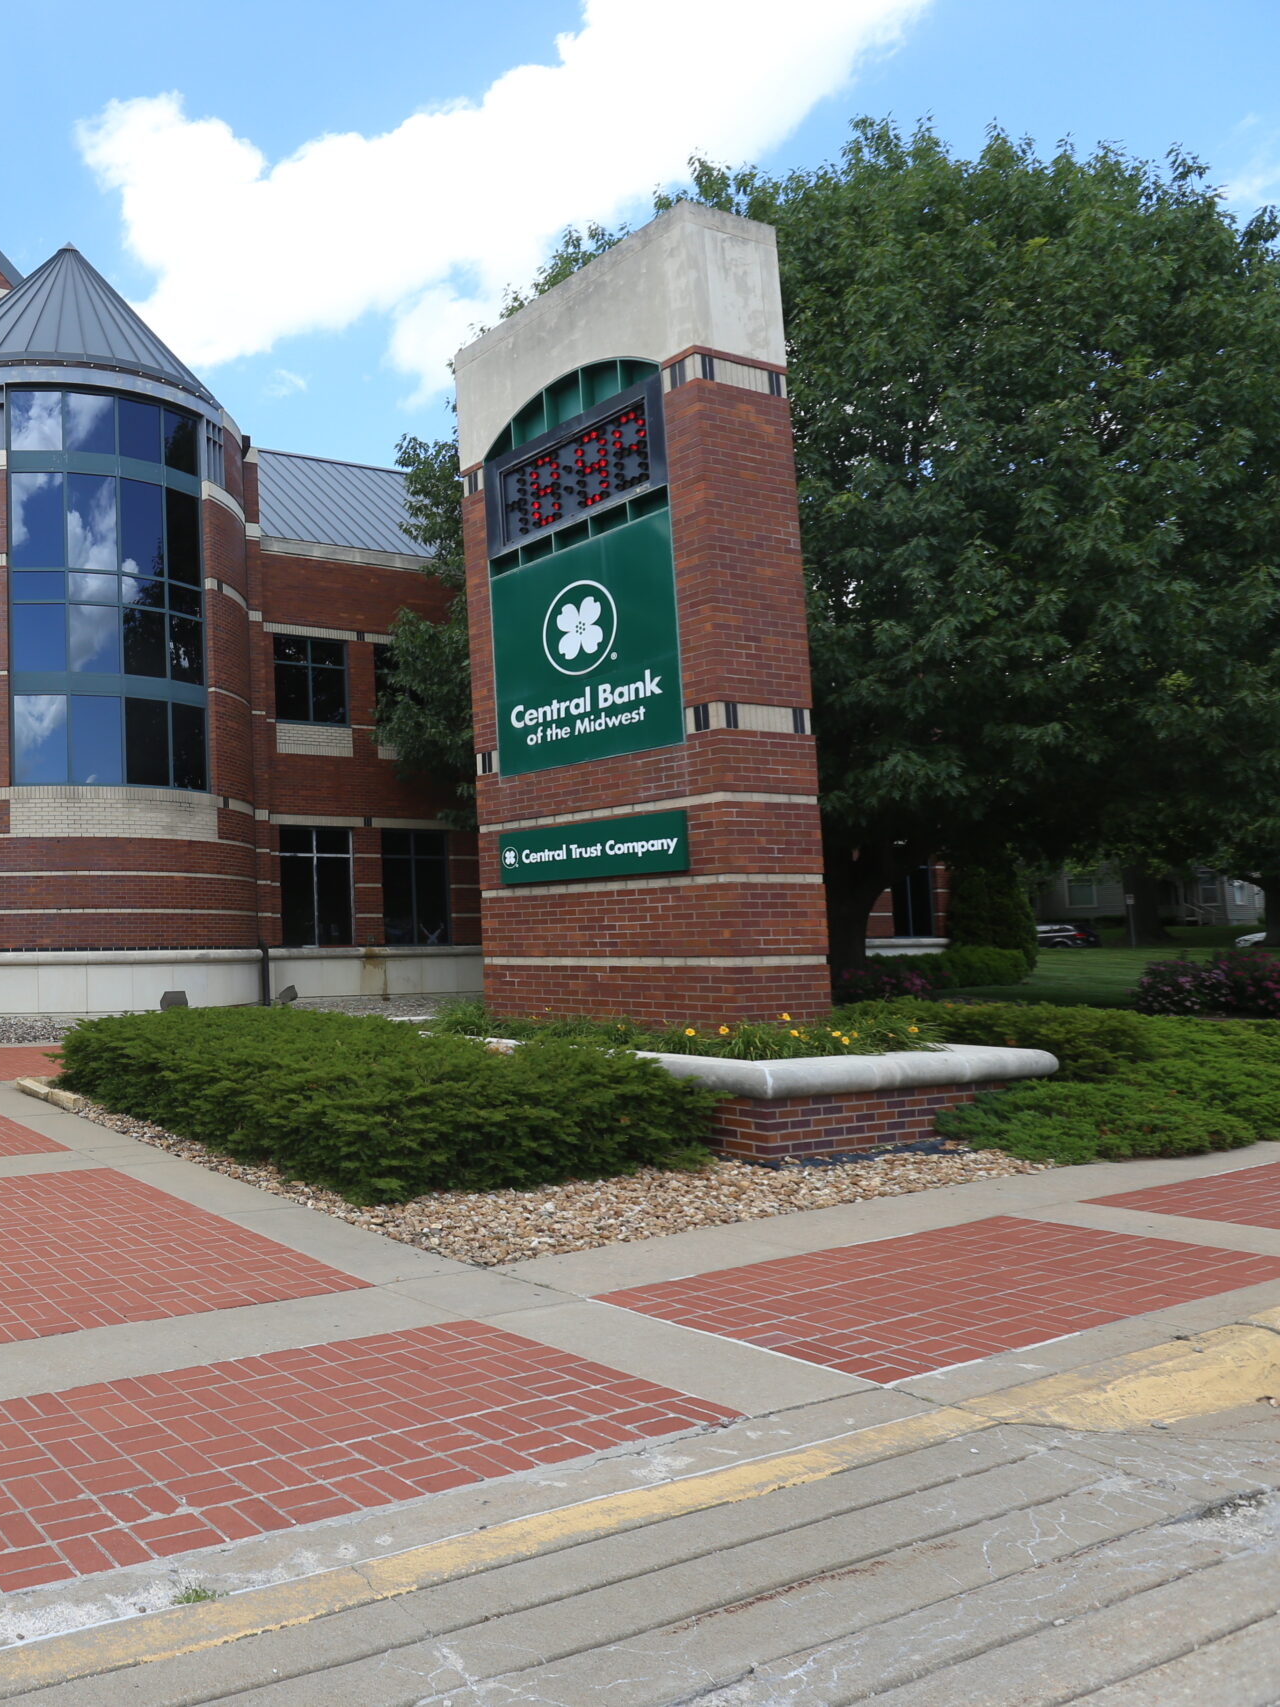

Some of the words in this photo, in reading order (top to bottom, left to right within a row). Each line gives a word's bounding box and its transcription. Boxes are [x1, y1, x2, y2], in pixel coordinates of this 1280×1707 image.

[510, 686, 591, 729] Central
[598, 669, 663, 709] Bank
[527, 727, 544, 746] of
[546, 723, 570, 742] the
[575, 705, 646, 736] Midwest
[522, 844, 567, 864] Central
[569, 843, 602, 859] Trust
[605, 837, 678, 857] Company
